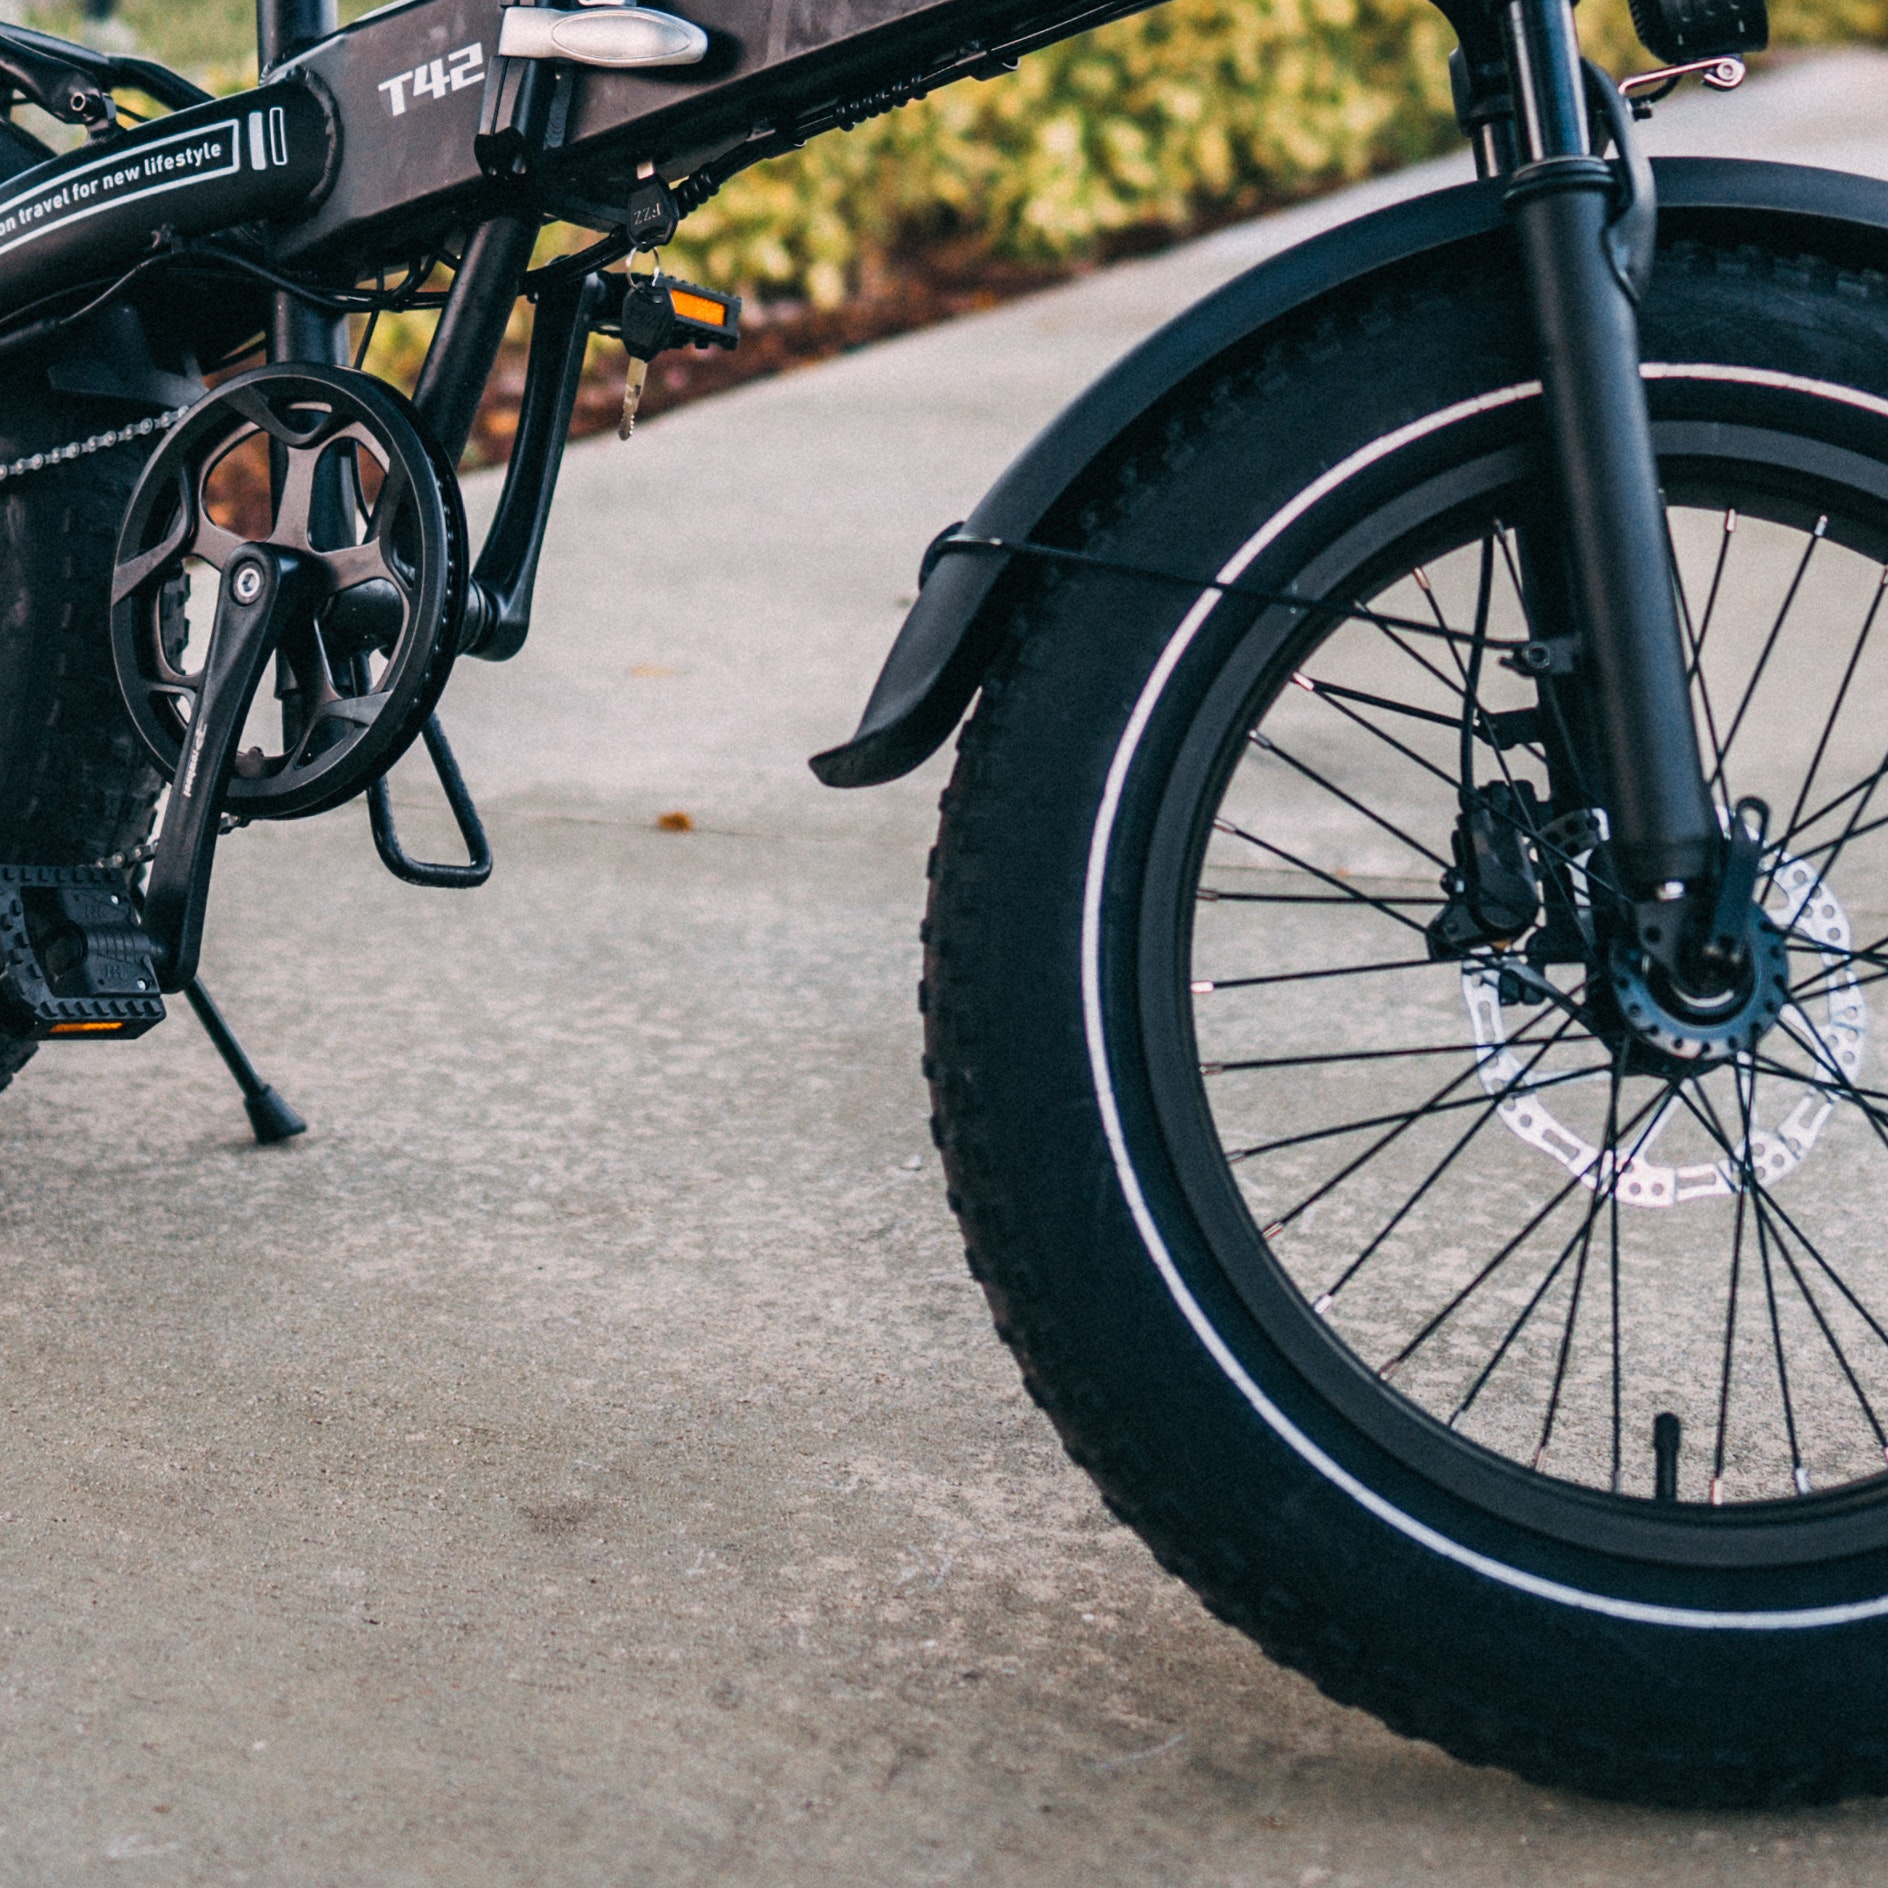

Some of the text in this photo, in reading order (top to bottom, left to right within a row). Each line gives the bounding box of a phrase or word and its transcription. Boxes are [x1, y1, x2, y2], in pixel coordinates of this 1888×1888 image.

[378, 42, 486, 116] T42
[19, 187, 70, 224] travel
[72, 180, 99, 202] for
[102, 166, 140, 190] new
[144, 142, 222, 176] lifestyle
